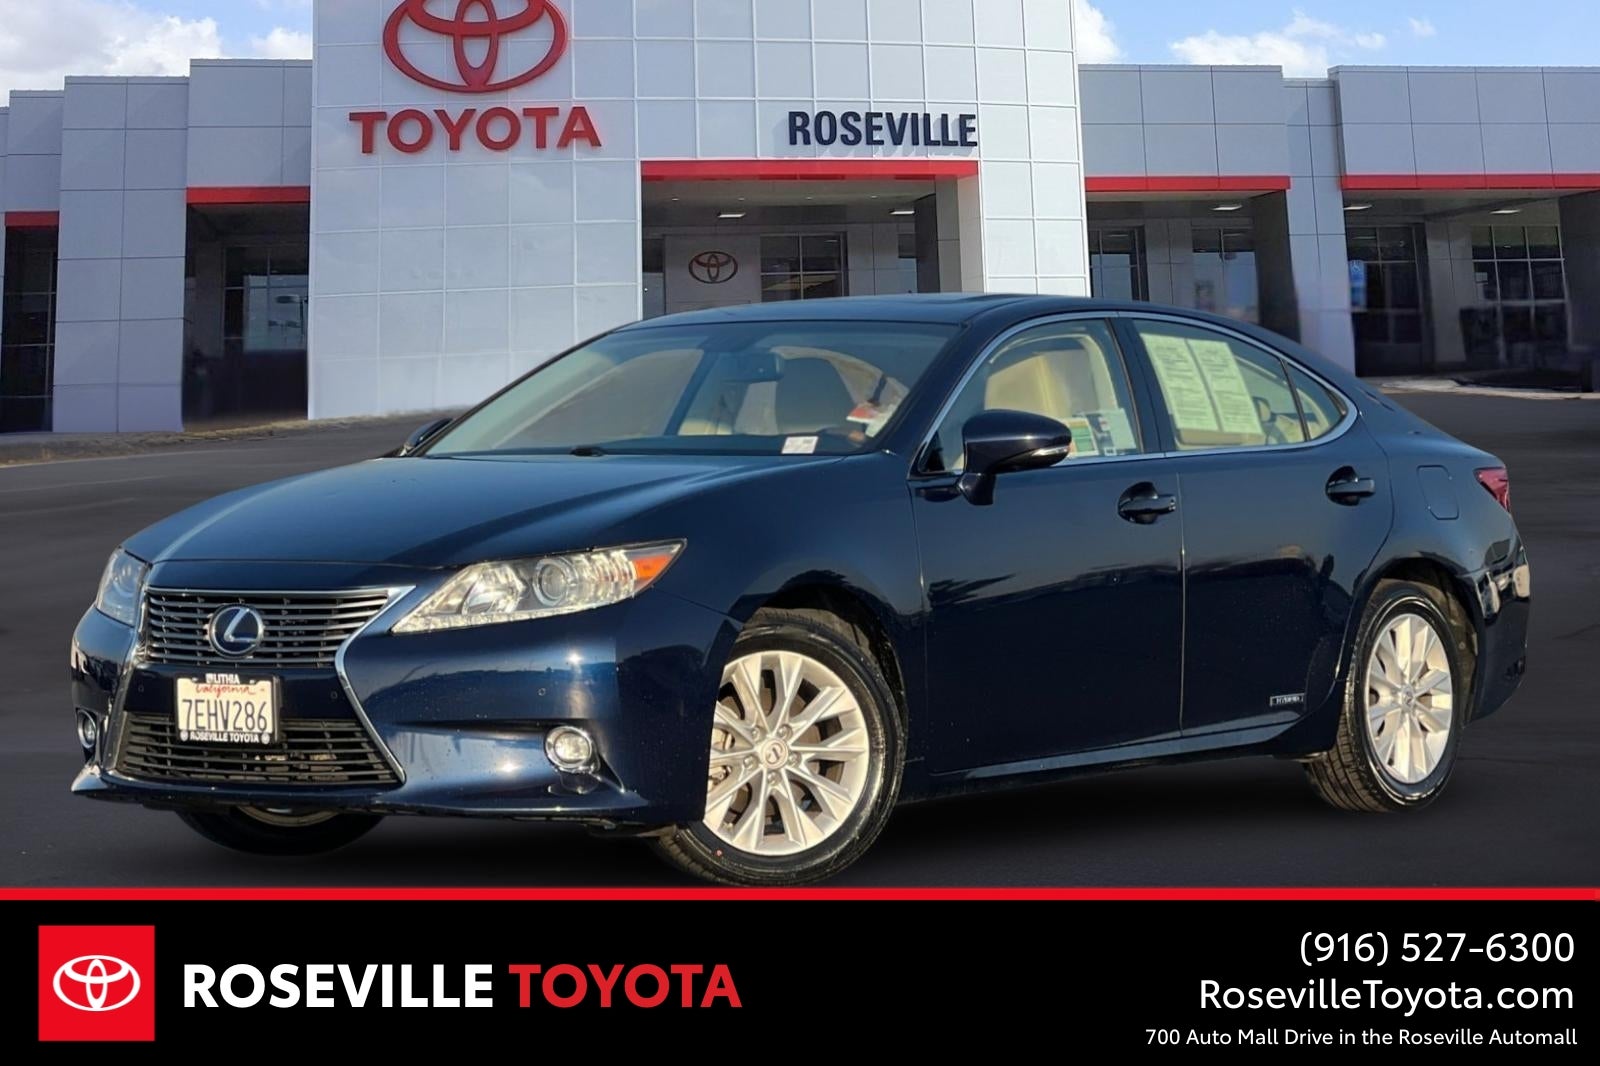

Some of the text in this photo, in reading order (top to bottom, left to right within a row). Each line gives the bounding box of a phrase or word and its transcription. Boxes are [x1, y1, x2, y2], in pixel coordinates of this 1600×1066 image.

[349, 106, 602, 153] TOYOTA
[788, 111, 978, 147] ROSEVILLE
[182, 699, 267, 732] 7EHV286
[190, 731, 259, 743] ROSEVILLE TOYOTA
